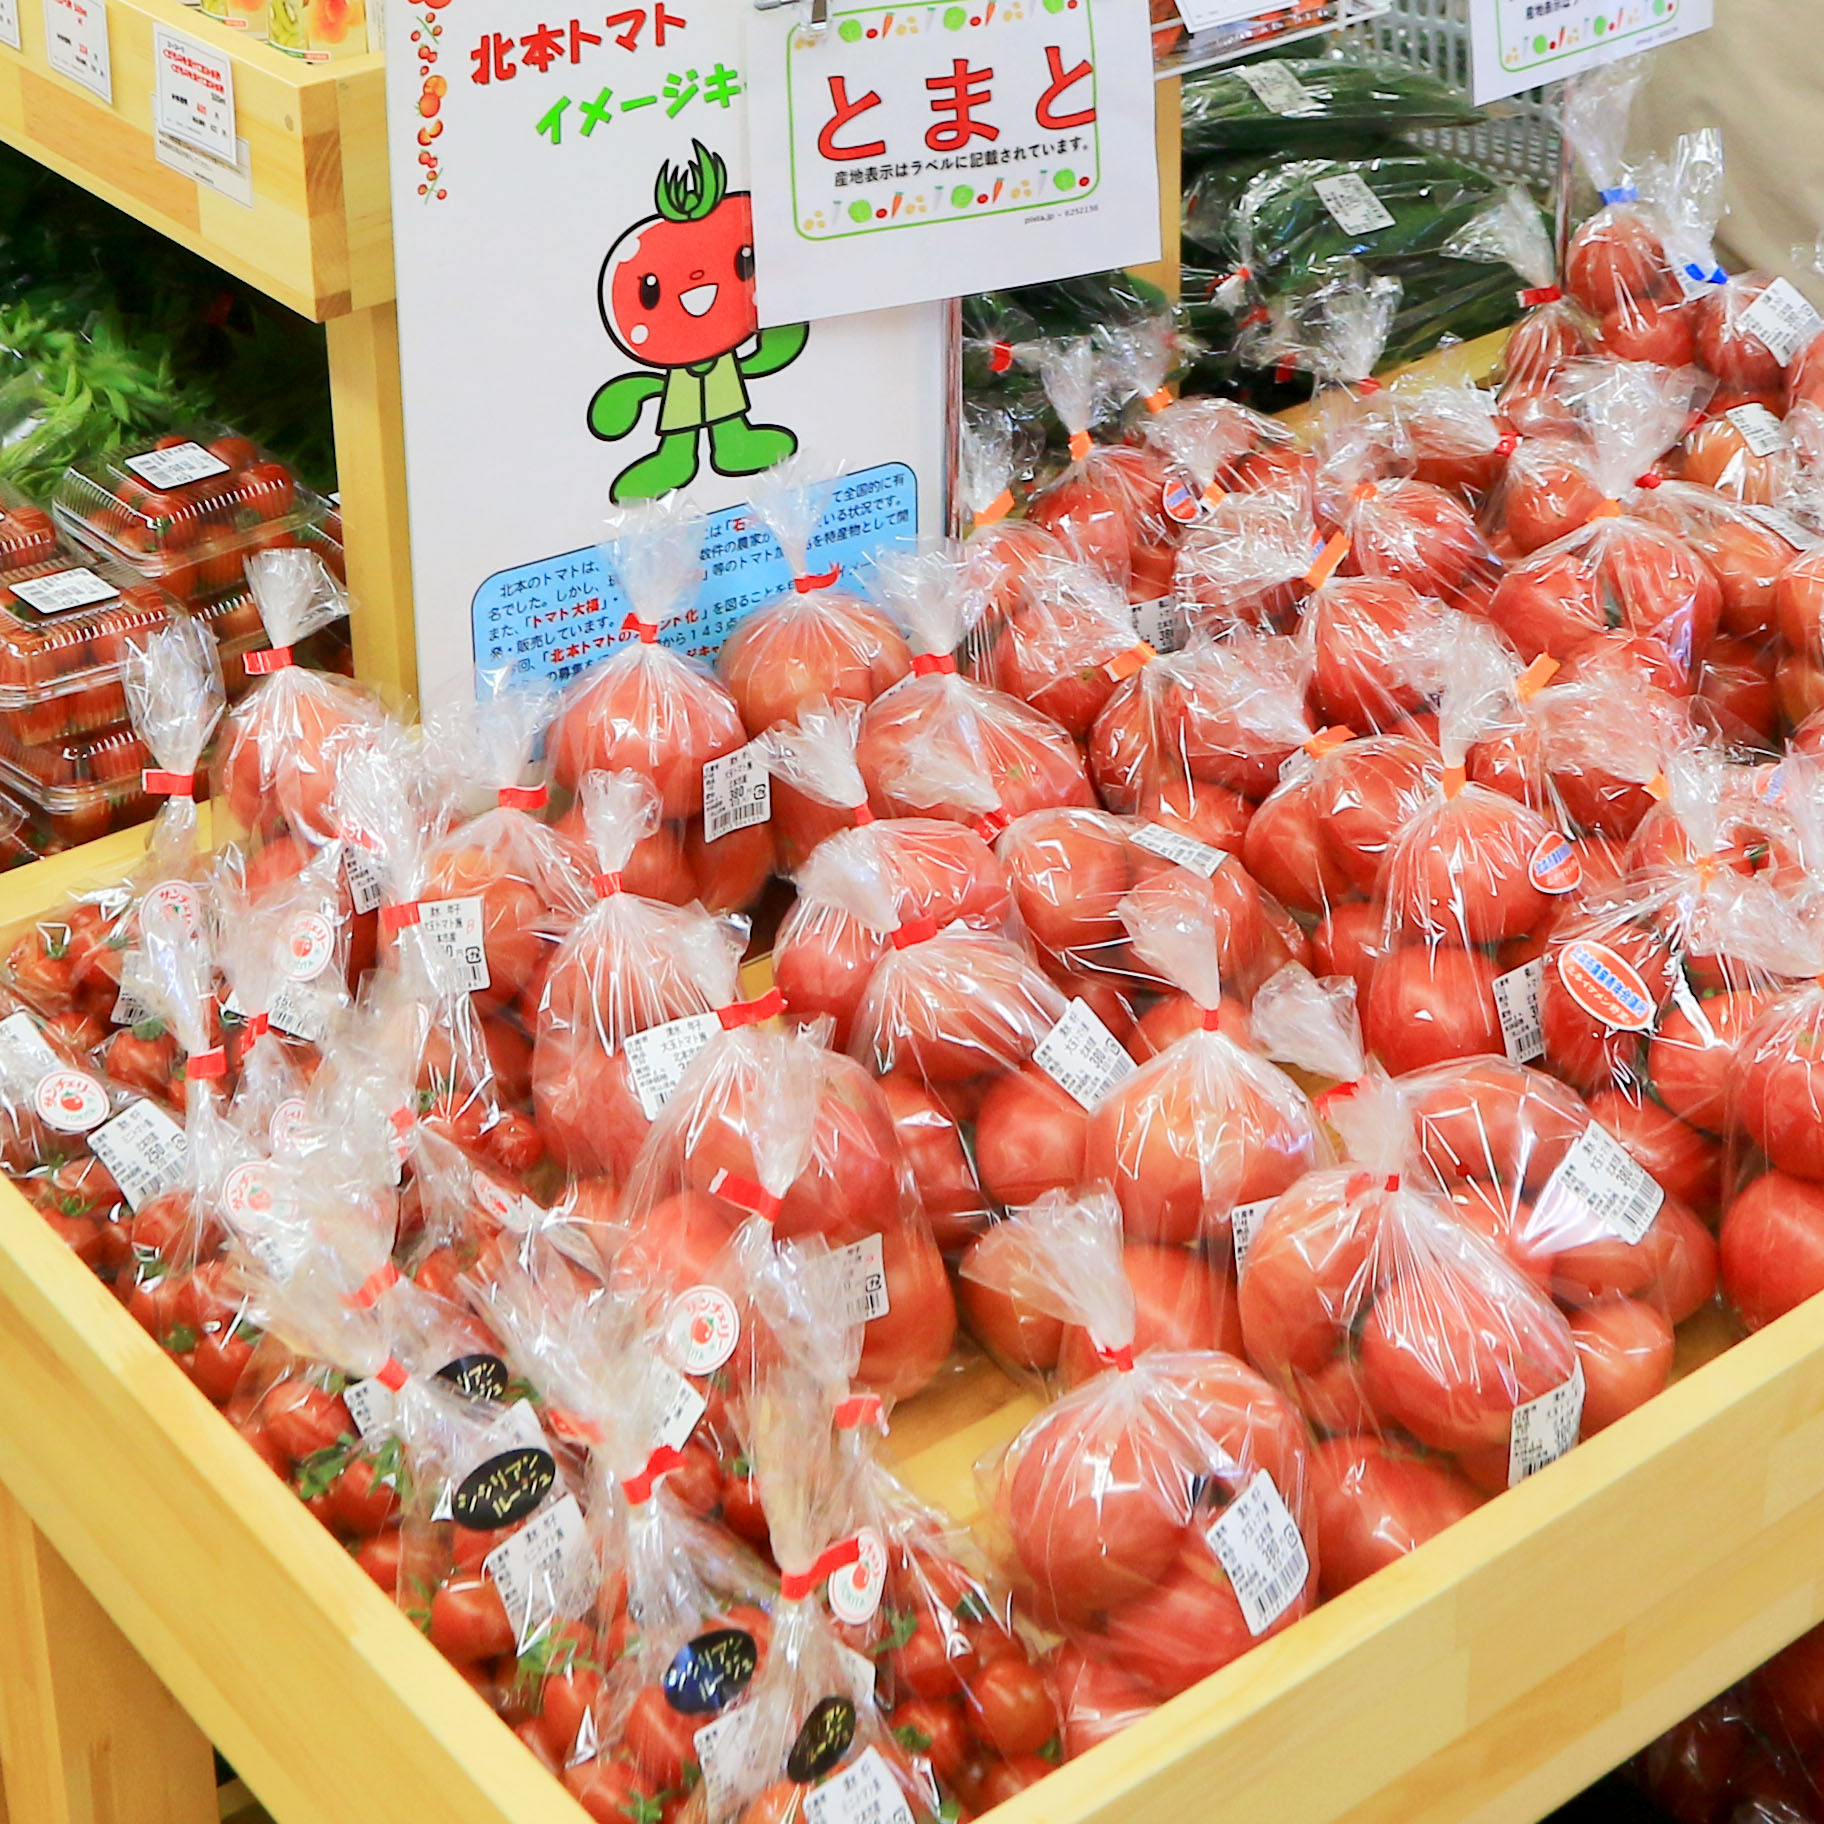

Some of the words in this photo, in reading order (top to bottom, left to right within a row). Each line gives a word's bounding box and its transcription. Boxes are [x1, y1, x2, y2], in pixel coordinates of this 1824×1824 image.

[471, 2, 687, 86] 北本トマト
[816, 44, 1098, 163] とまと
[834, 136, 1089, 188] 産地表示はラベルに記載されています。
[500, 561, 601, 597] 北本のトマトは、
[729, 785, 746, 798] 380
[144, 1143, 165, 1166] 250
[457, 1455, 538, 1513] シシリアン
[491, 1471, 552, 1518] ルージュ
